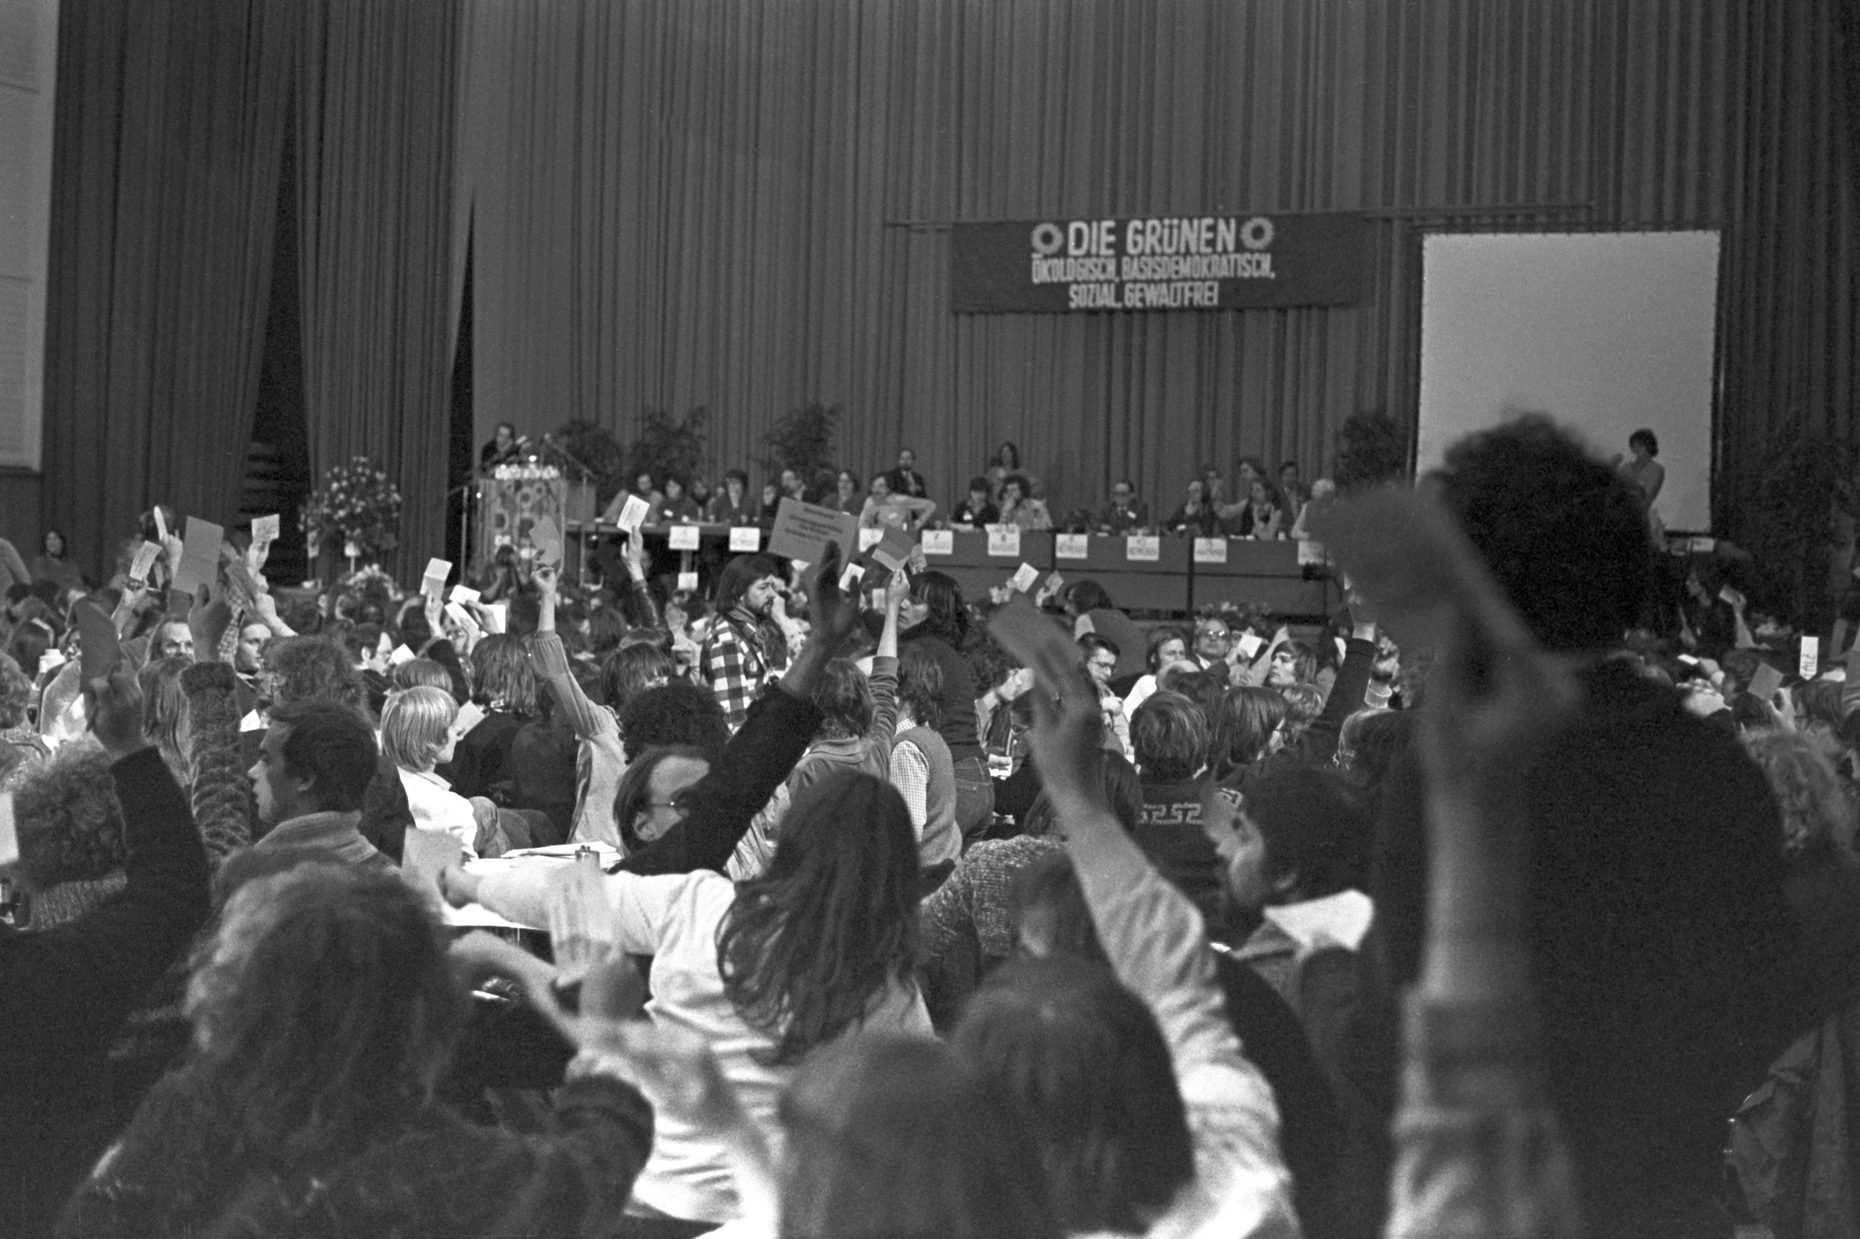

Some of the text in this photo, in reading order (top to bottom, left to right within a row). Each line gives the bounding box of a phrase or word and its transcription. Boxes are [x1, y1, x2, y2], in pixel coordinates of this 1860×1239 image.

[1069, 218, 1235, 256] DIE GRÜNEN
[1124, 282, 1219, 308] GEWALTFREI
